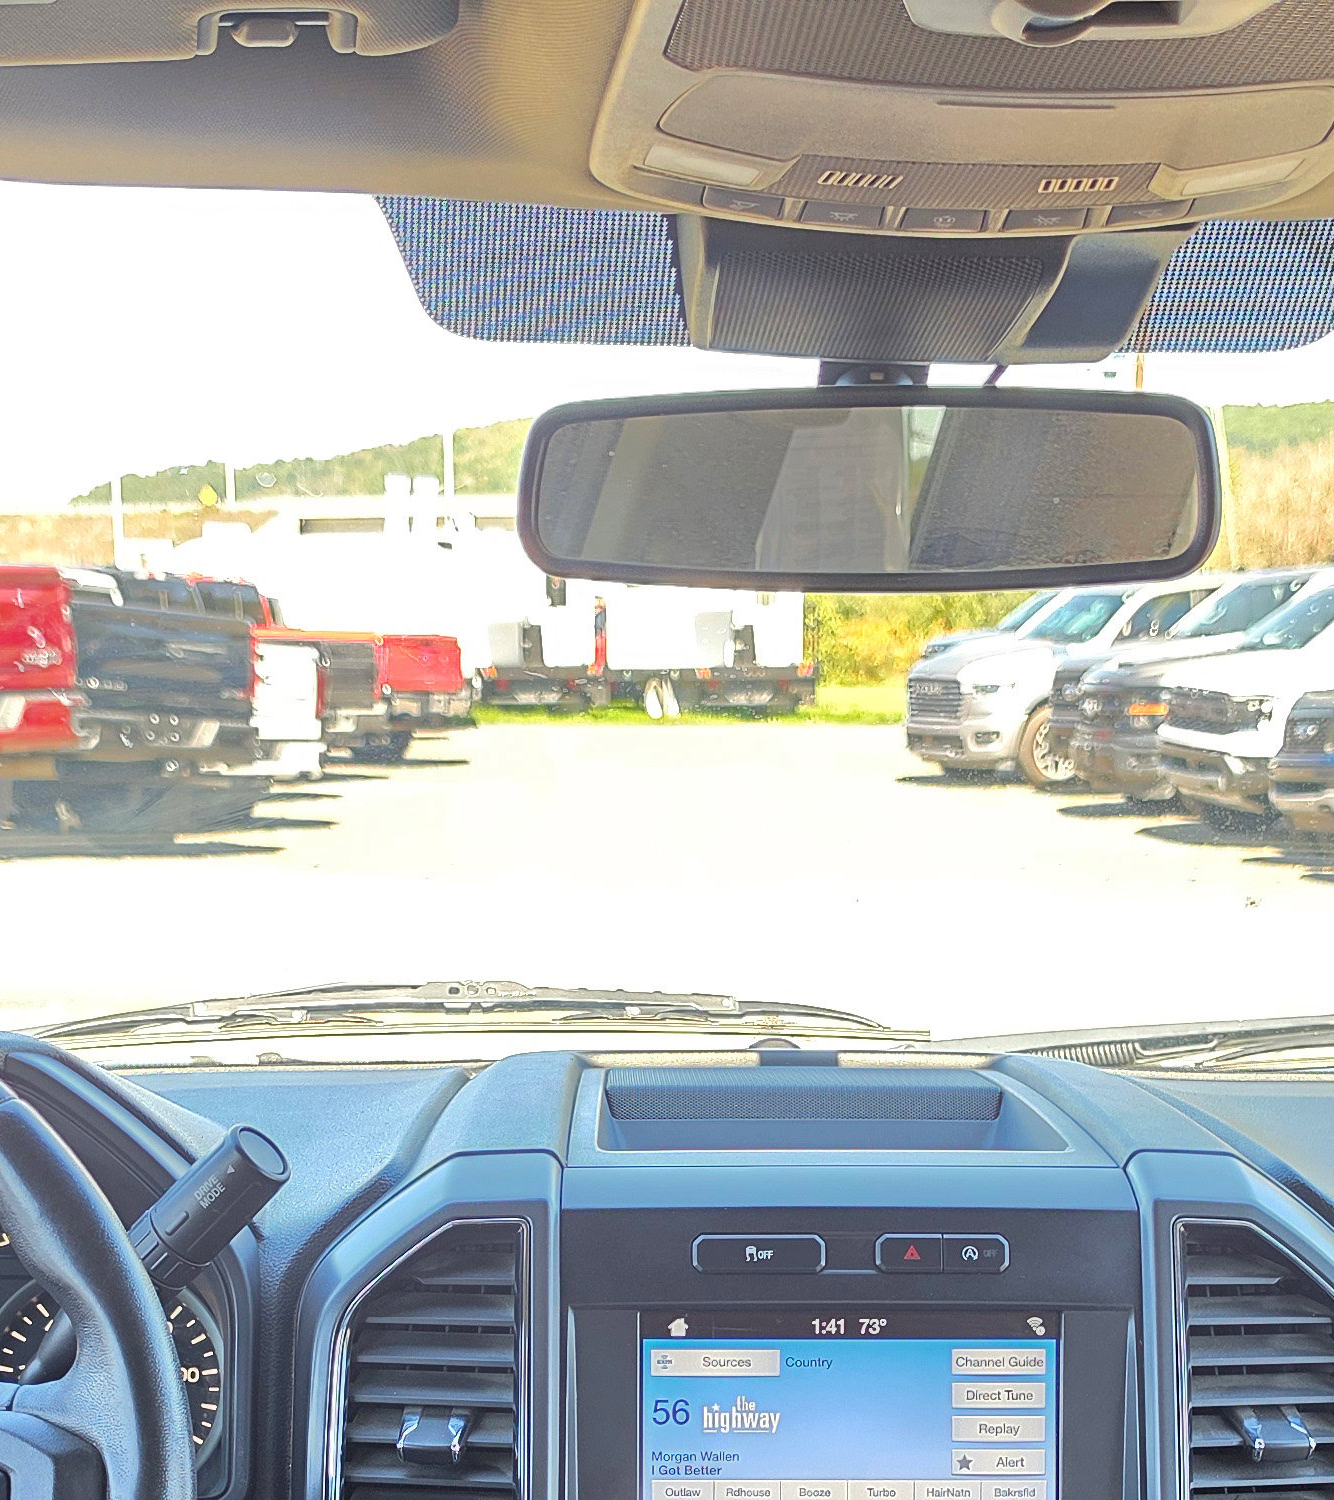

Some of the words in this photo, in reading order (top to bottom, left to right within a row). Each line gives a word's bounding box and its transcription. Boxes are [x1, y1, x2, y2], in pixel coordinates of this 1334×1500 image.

[193, 1173, 220, 1201] DRIVE
[198, 1181, 227, 1210] MODE
[757, 1250, 774, 1260] OFF
[811, 1318, 845, 1335] 1:41
[858, 1318, 888, 1335] 73°
[702, 1356, 752, 1368] Sources
[785, 1356, 833, 1370] Country
[955, 1356, 1005, 1368] Channel
[1008, 1356, 1044, 1368] Guide
[965, 1389, 1001, 1401] Direct
[1004, 1389, 1034, 1401] Tune
[736, 1395, 756, 1411] the
[652, 1398, 690, 1426] 56
[702, 1403, 781, 1434] highway
[978, 1423, 1020, 1437] Replay
[651, 1451, 697, 1464] Morgan
[700, 1451, 740, 1462] Wallen
[995, 1456, 1025, 1468] Alert
[658, 1465, 681, 1476] Got
[684, 1465, 723, 1476] Better
[665, 1488, 701, 1498] Outlaw
[726, 1487, 771, 1497] Rdhouse
[799, 1487, 831, 1497] Booze
[867, 1487, 897, 1498] Turbo
[926, 1487, 971, 1498] HairNatn
